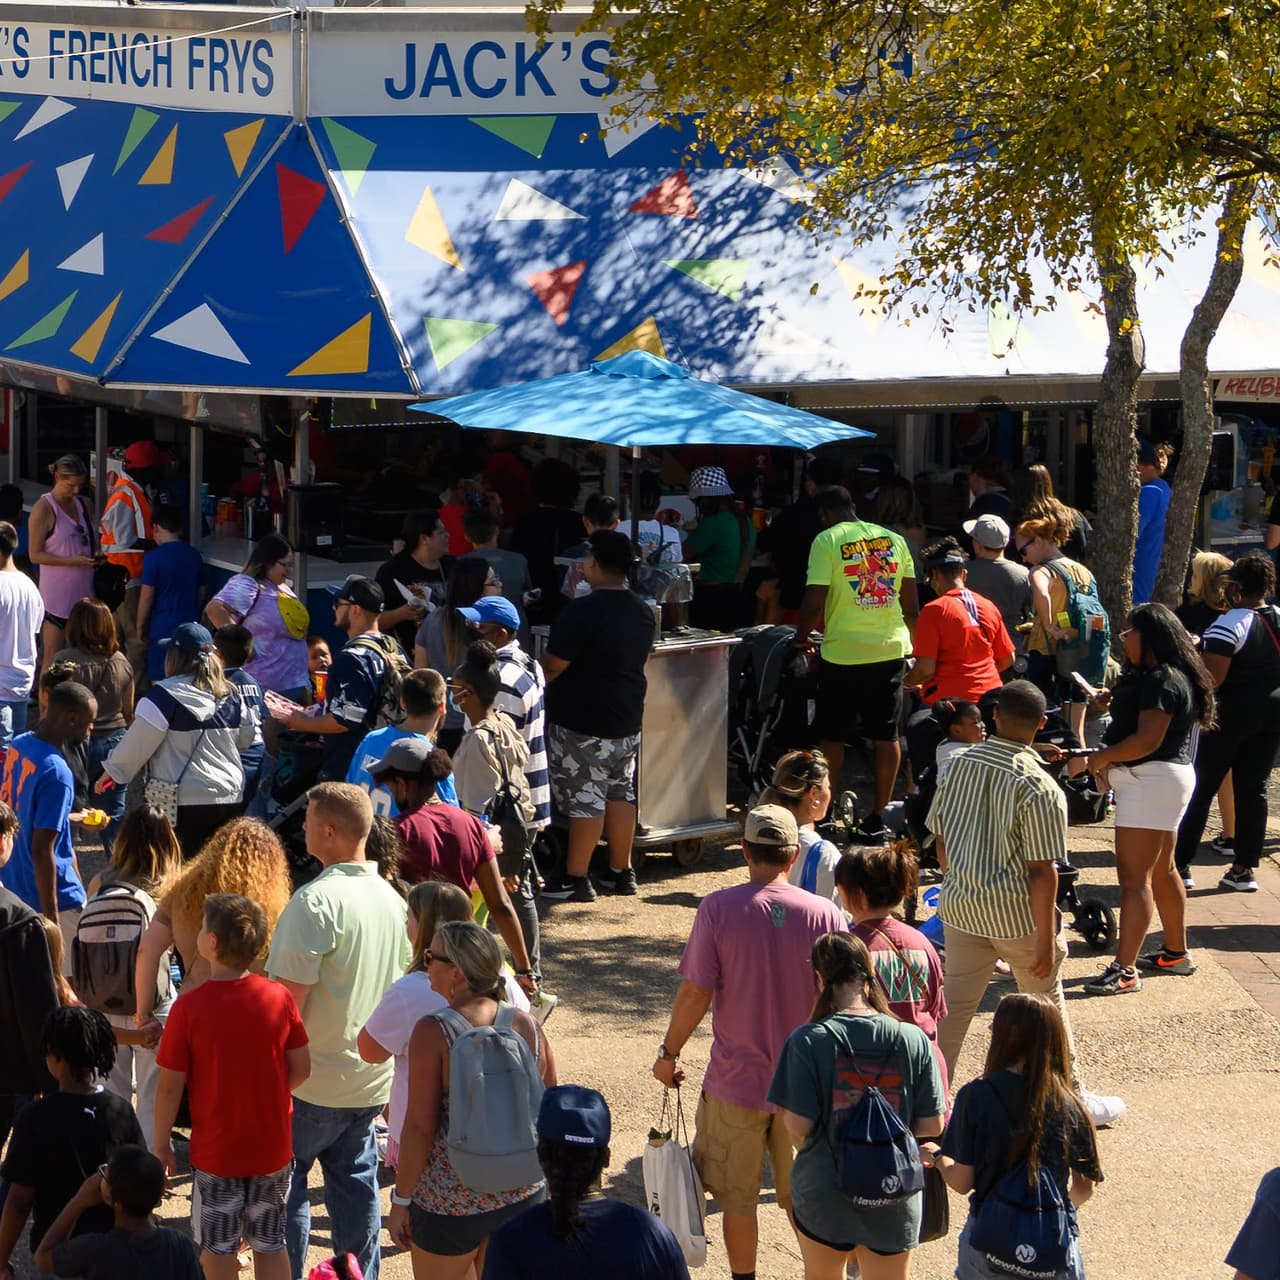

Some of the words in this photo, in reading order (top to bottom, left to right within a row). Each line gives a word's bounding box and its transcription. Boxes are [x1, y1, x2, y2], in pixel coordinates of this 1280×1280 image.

[48, 29, 172, 88] FRENCH
[187, 37, 275, 97] FRYS
[384, 39, 620, 100] JACK'S
[986, 1253, 1056, 1280] NewHarvest
